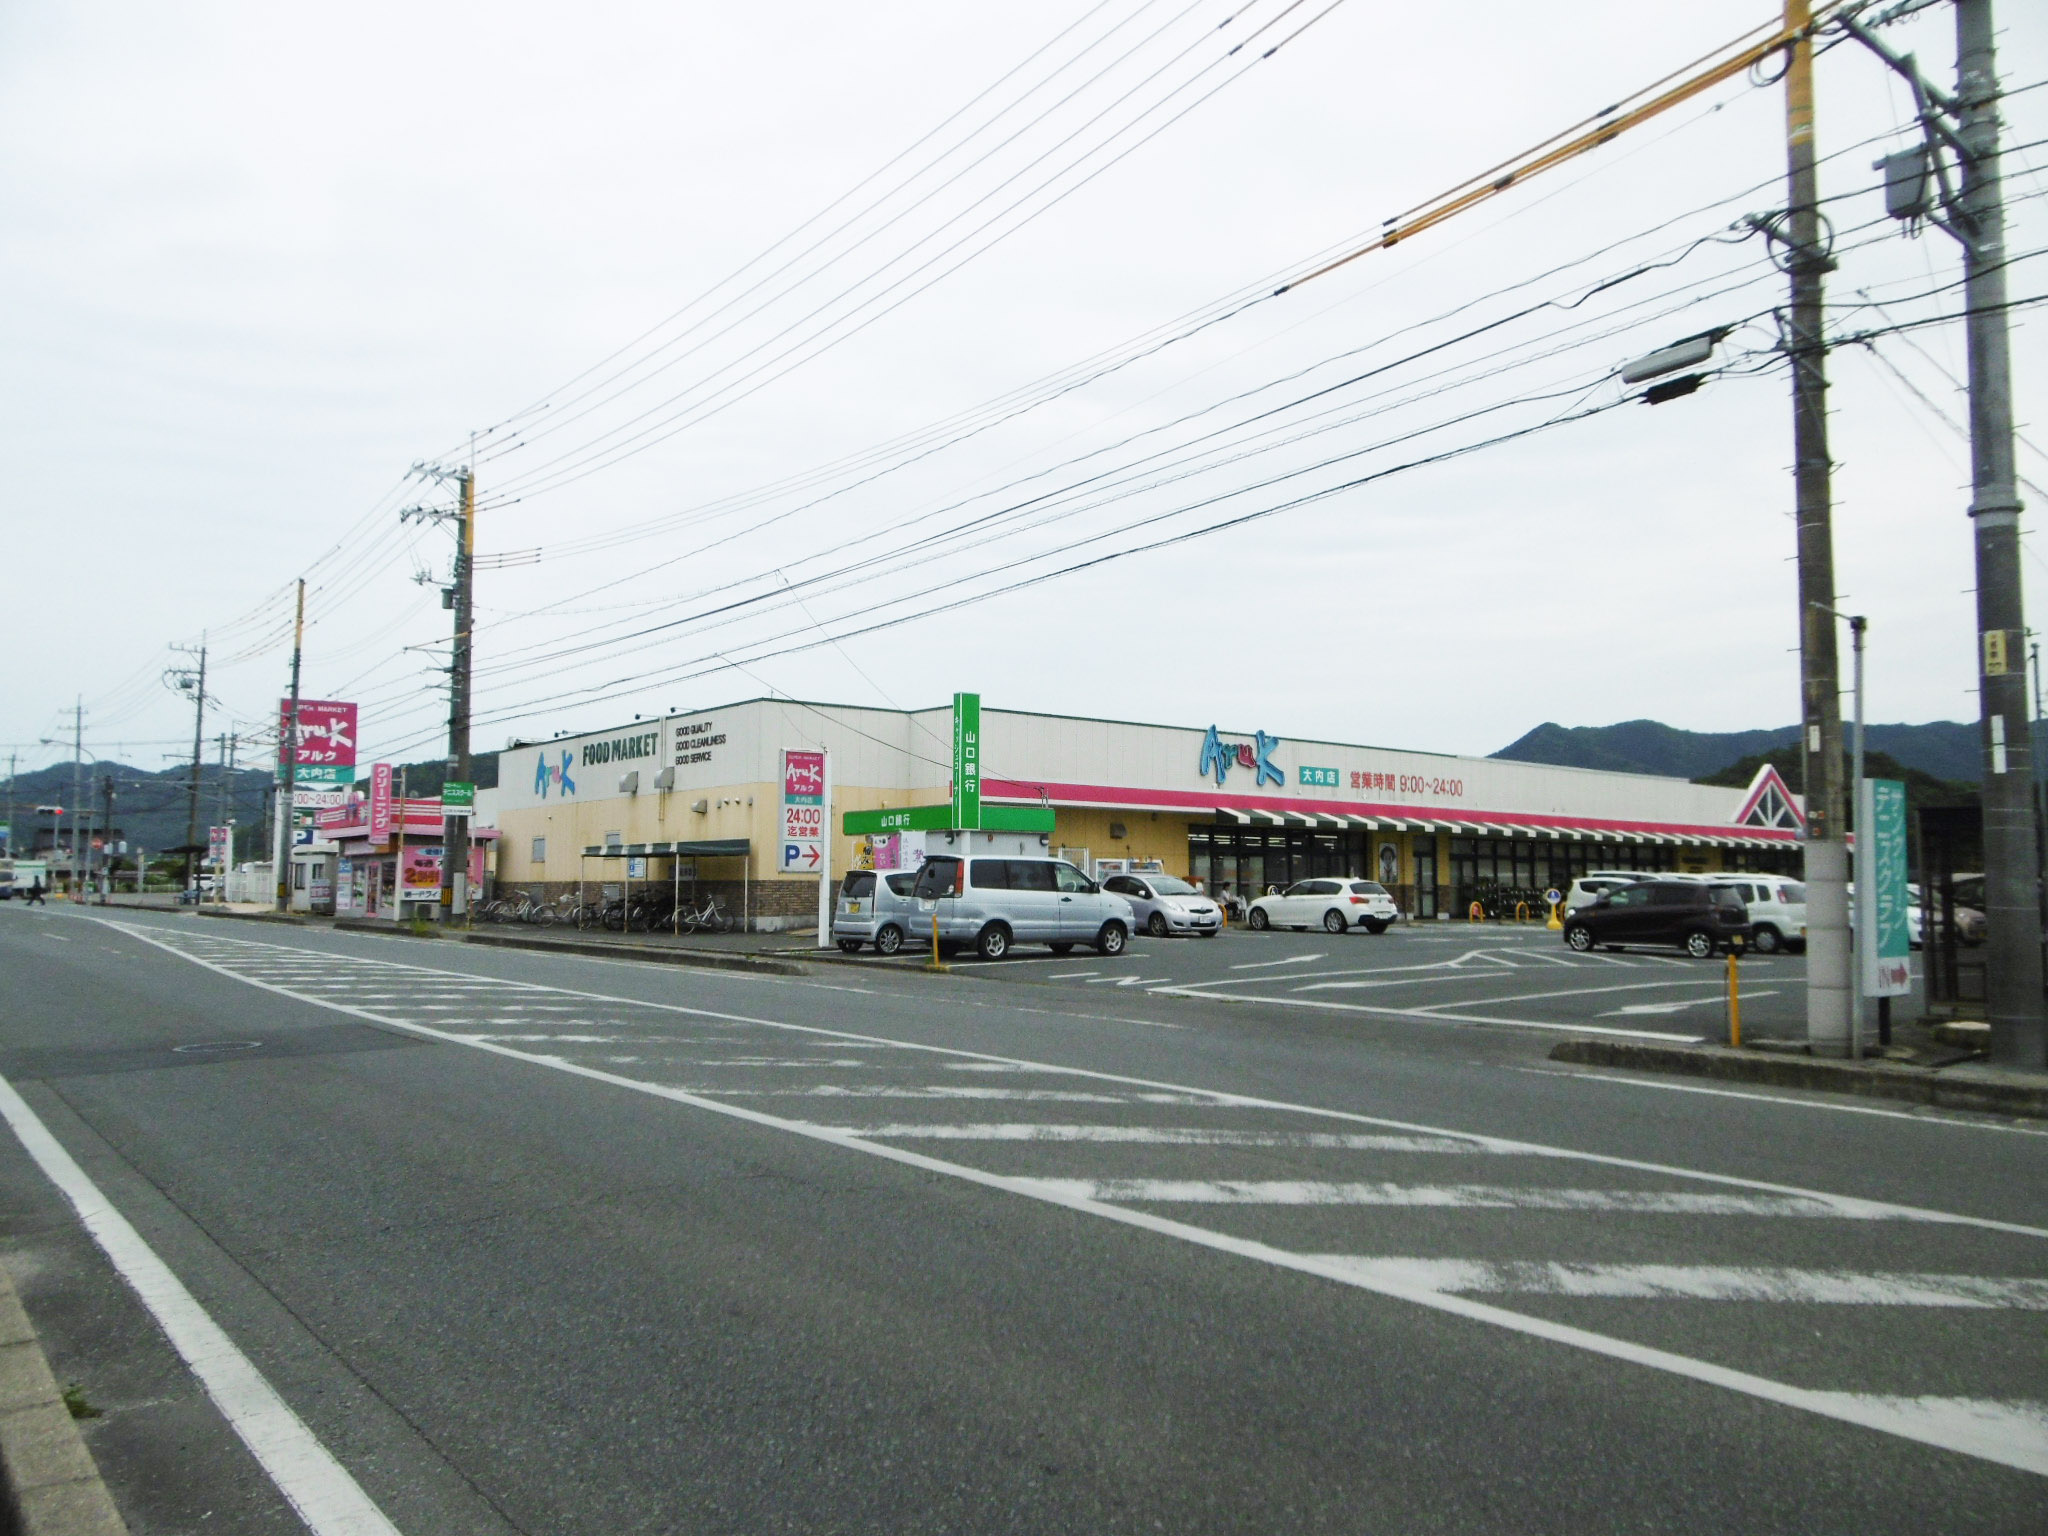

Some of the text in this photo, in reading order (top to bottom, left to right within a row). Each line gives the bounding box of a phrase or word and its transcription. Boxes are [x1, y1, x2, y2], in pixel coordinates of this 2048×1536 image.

[675, 722, 713, 737] GOOD QUALITY
[582, 732, 659, 767] FOOD MARKET
[675, 734, 727, 751] GOOD CLEANLINESS
[298, 750, 337, 762] アルク
[675, 751, 712, 765] GOOD SERVICE
[965, 731, 976, 793] 山口銀行
[297, 767, 337, 780] 大内店
[1302, 768, 1336, 784] 大内店
[1350, 771, 1396, 792] 営業時間
[793, 784, 815, 792] アルク
[375, 766, 388, 829] クリーニング
[787, 808, 821, 825] 24:00
[881, 813, 911, 827] 山口銀行
[293, 830, 308, 844] P
[787, 825, 820, 837] 迄営業
[785, 844, 801, 867] P
[1878, 966, 1890, 989] IN
